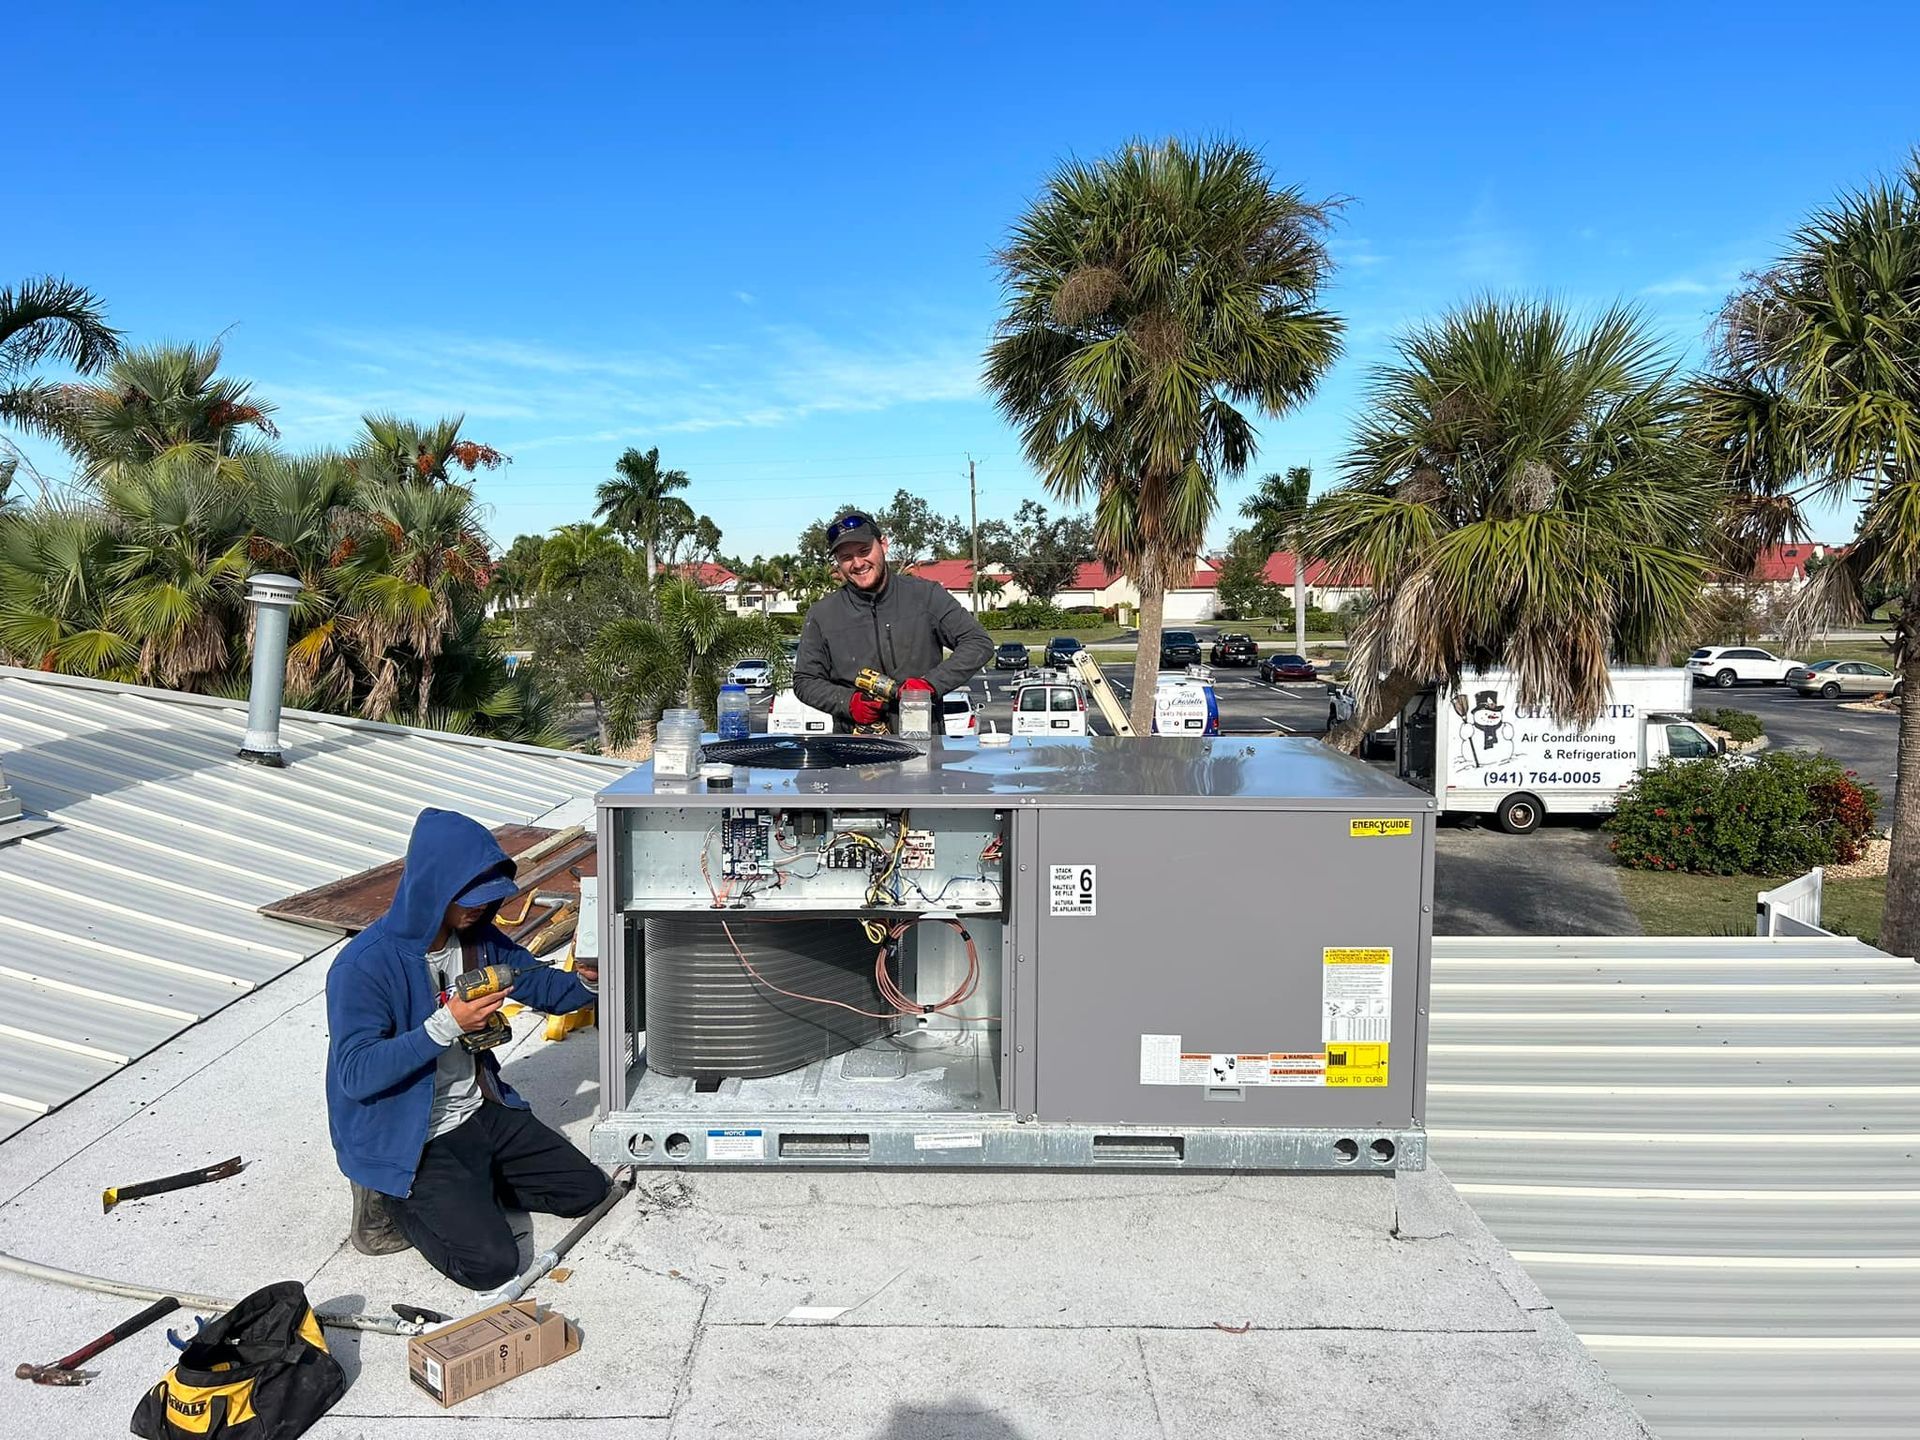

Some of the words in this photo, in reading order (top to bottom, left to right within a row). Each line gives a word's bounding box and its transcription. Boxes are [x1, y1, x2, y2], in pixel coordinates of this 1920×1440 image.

[1515, 704, 1635, 719] CHATE
[1521, 733, 1538, 743] Air
[1541, 733, 1616, 745] Conditioning
[1543, 749, 1553, 760] &
[1557, 749, 1636, 761] Refrigeration
[1483, 771, 1523, 787] (941)
[1529, 771, 1601, 784] 764-0005
[1352, 820, 1410, 831] ENERGYGUIDE
[1080, 868, 1093, 892] 6
[500, 1344, 508, 1358] 60
